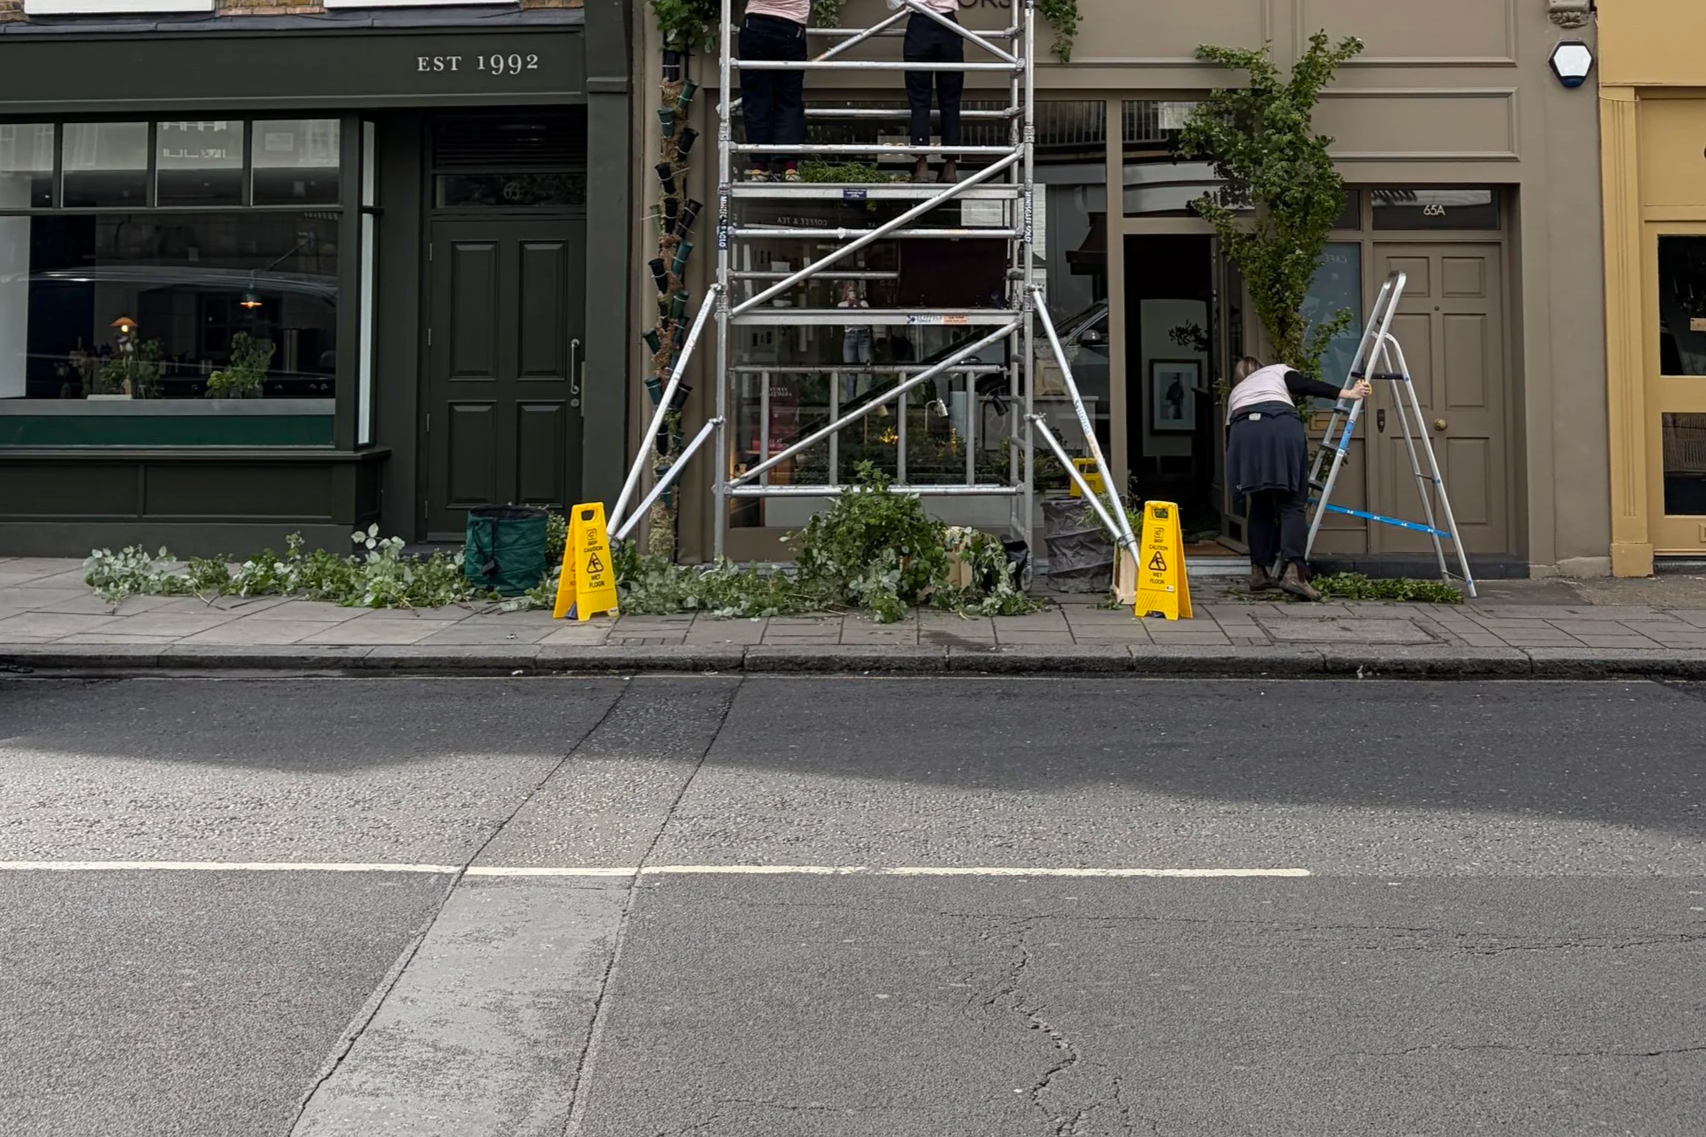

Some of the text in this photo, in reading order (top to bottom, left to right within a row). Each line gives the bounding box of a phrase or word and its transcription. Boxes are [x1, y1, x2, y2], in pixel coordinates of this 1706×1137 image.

[417, 53, 539, 75] EST 1992
[1423, 204, 1446, 216] 65A
